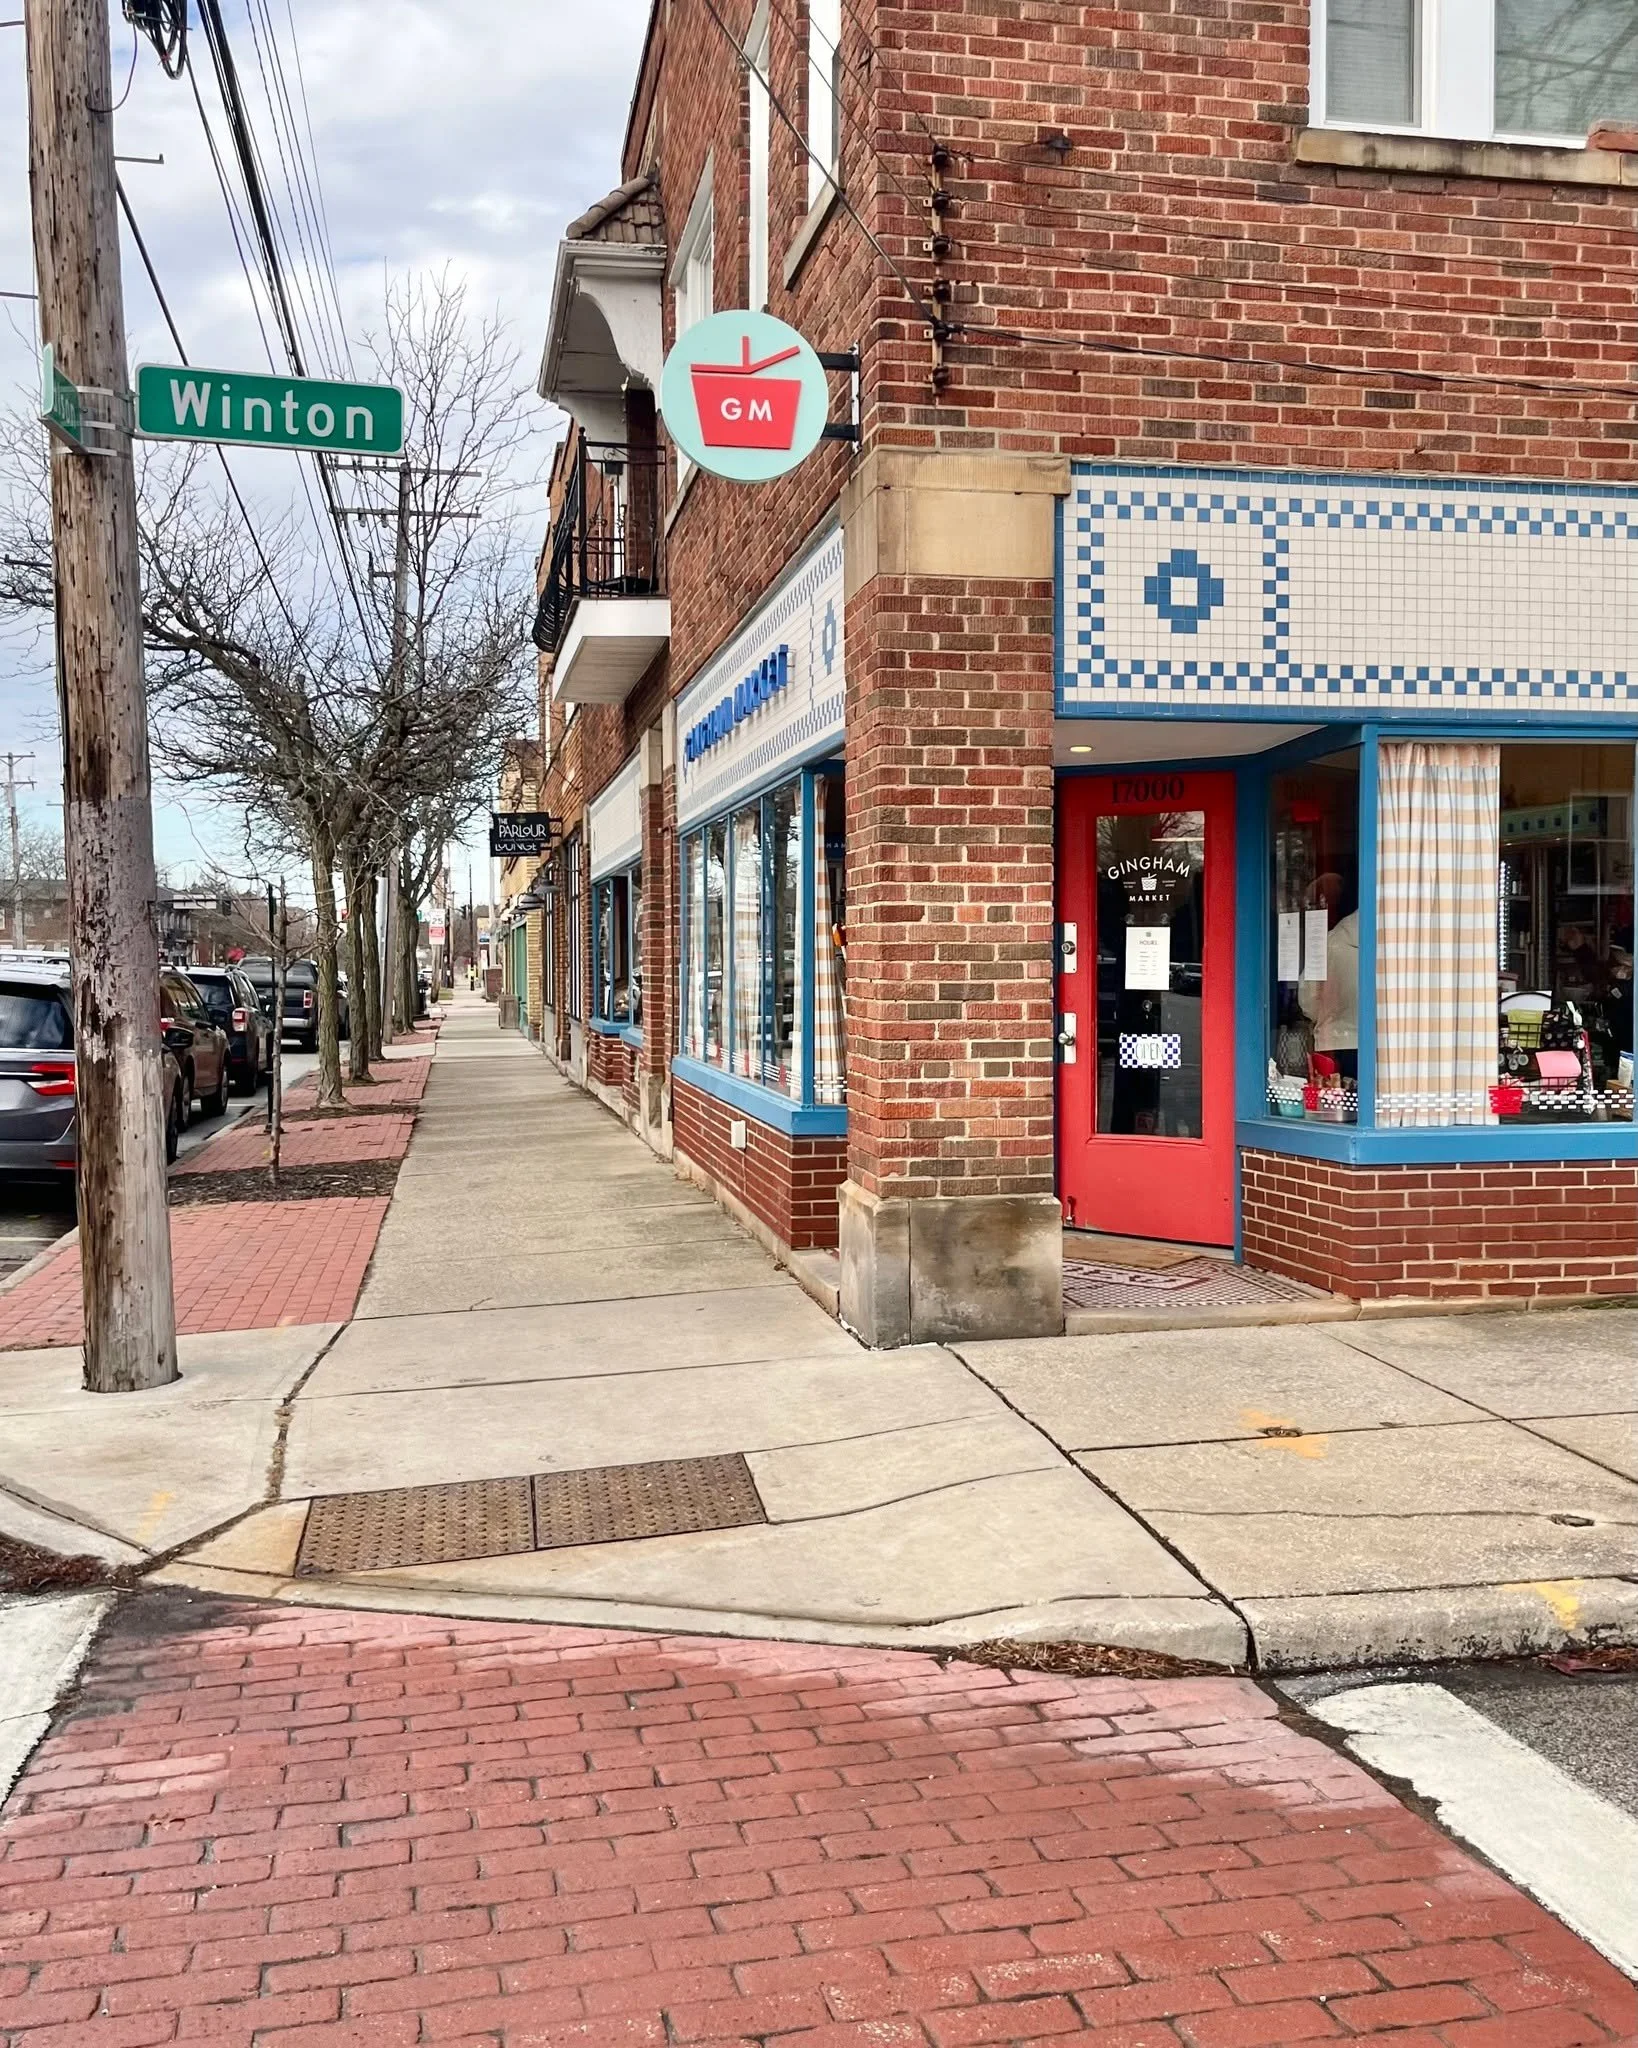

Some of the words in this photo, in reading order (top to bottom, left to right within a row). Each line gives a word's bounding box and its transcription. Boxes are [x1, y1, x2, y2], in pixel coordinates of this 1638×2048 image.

[170, 379, 374, 441] Winton
[720, 397, 773, 422] GM
[1111, 777, 1185, 803] 17000
[499, 823, 546, 838] PARLOUR
[1107, 856, 1190, 880] GINGHAM
[1129, 894, 1170, 902] MARKET
[431, 917, 443, 925] 25
[1135, 1043, 1164, 1060] OPEN
